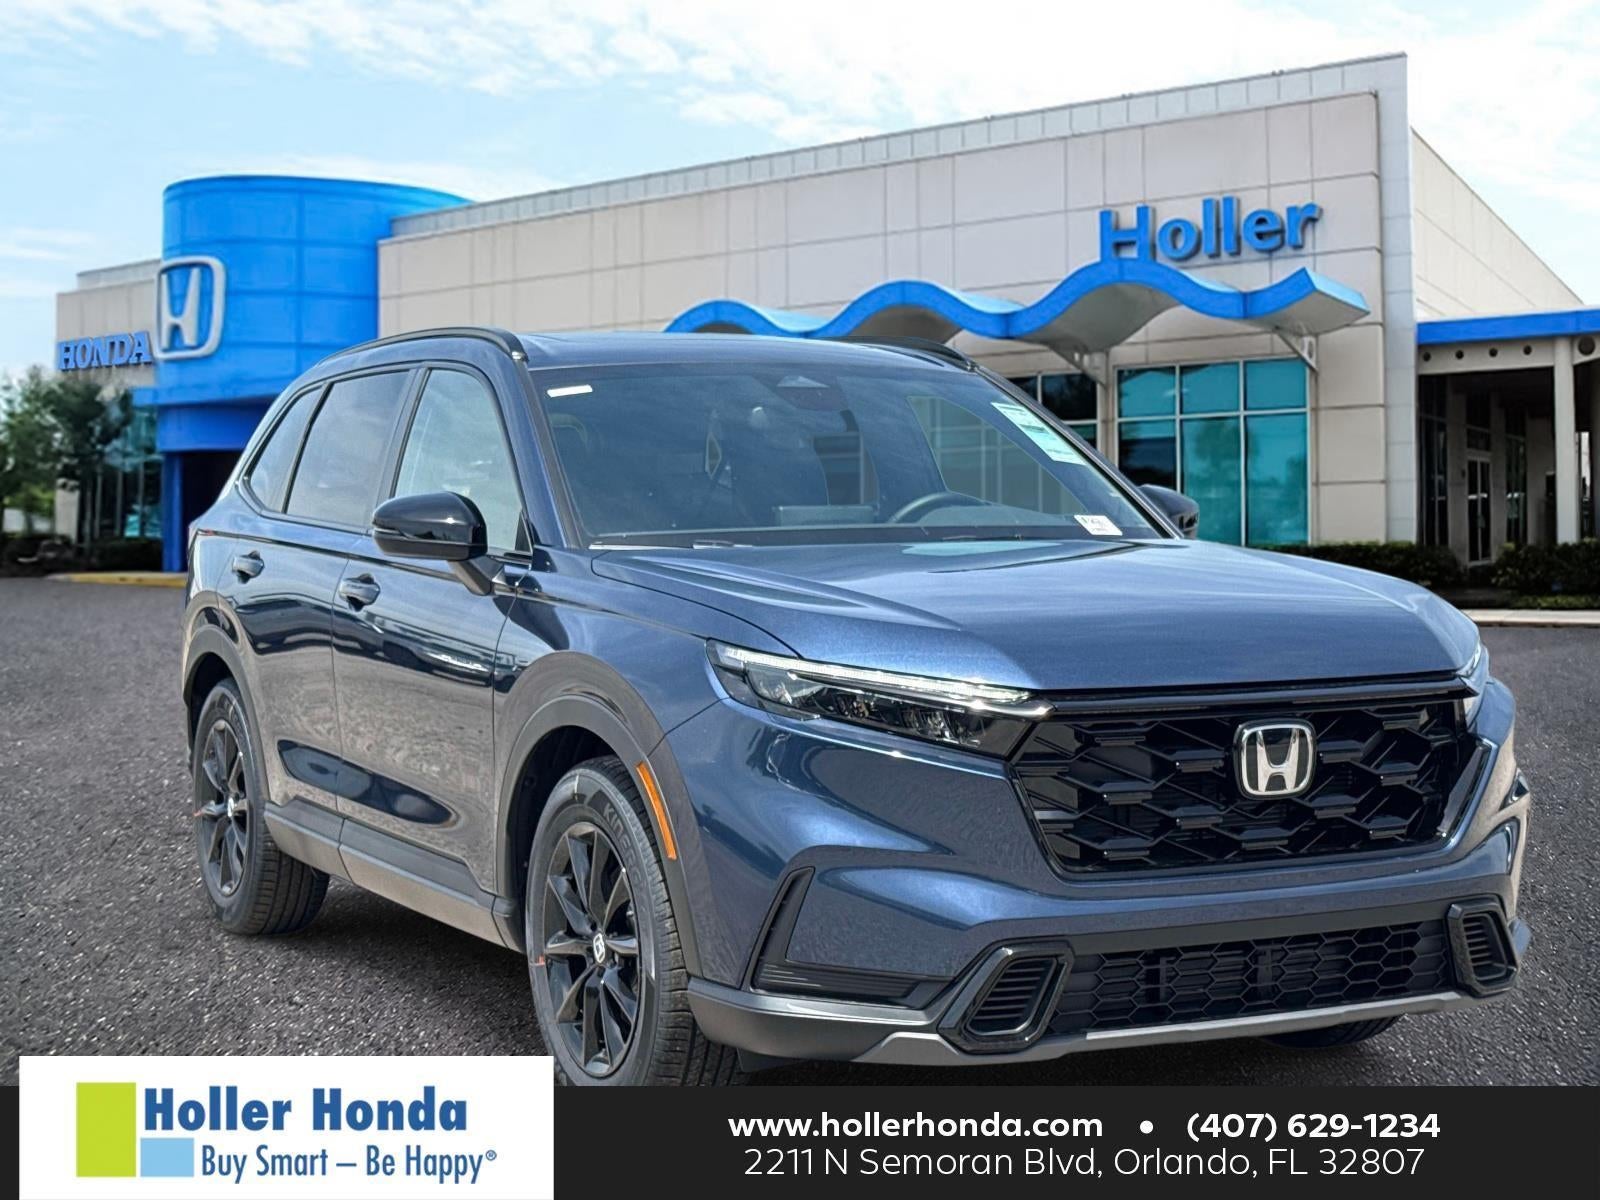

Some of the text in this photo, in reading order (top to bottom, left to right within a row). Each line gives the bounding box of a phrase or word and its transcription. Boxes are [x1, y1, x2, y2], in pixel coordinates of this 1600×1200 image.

[1099, 196, 1321, 261] Holler
[58, 331, 153, 370] HONDA
[603, 802, 647, 892] KINERG
